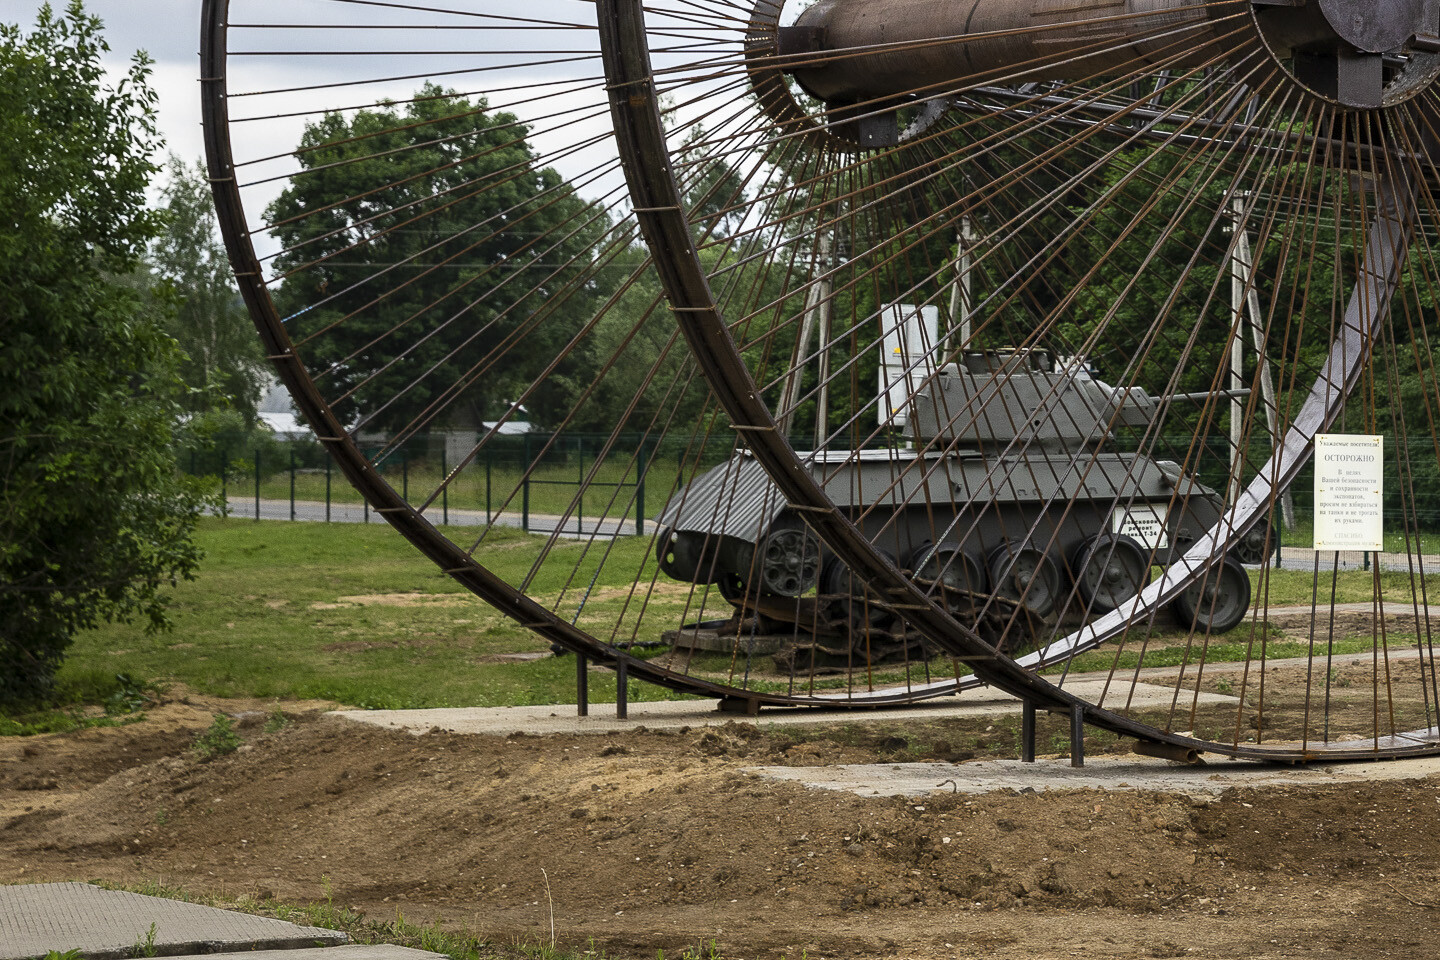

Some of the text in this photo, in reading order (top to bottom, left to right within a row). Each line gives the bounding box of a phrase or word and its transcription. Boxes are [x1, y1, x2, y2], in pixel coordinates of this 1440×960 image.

[1324, 454, 1375, 462] ОСТОРОЖНО
[1341, 476, 1377, 484] безопасности
[1349, 501, 1378, 509] взбираться
